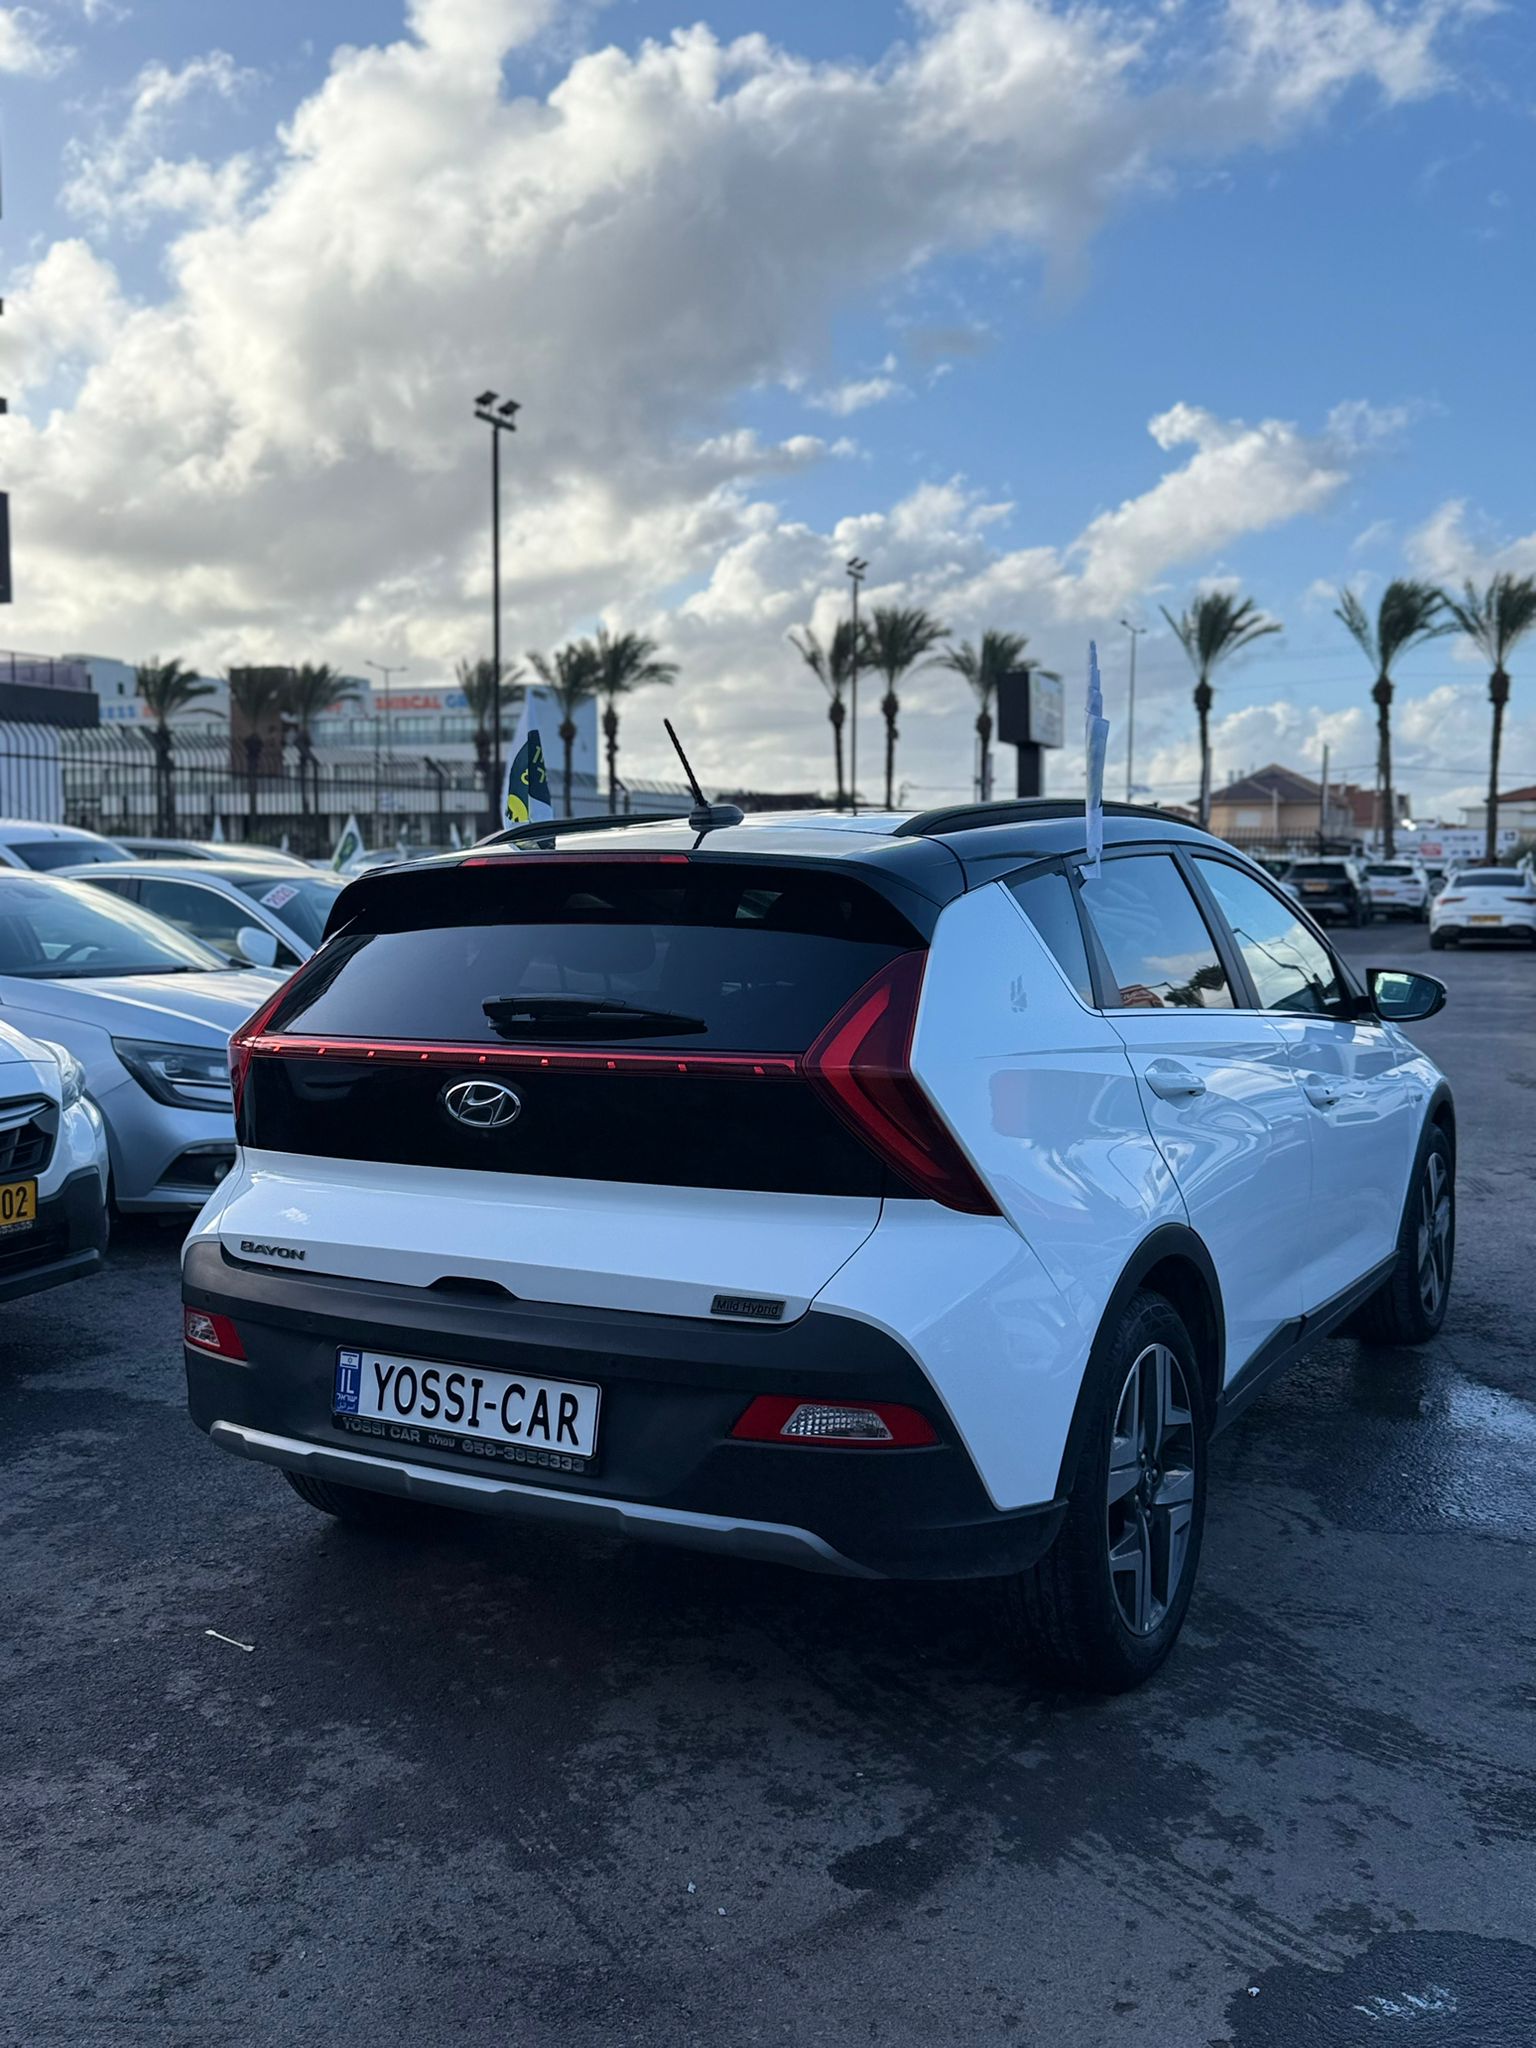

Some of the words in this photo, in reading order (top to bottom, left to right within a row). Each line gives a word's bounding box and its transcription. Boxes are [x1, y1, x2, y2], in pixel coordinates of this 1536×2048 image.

[2, 1186, 28, 1220] 02
[240, 1240, 306, 1261] BAYON
[716, 1299, 740, 1311] Mild
[743, 1302, 779, 1315] Hybrid
[340, 1368, 355, 1394] IL
[336, 1392, 358, 1403] ישראל
[374, 1362, 579, 1446] YOSSI-CAR
[342, 1416, 386, 1437] YOSSI
[390, 1425, 421, 1443] CAR
